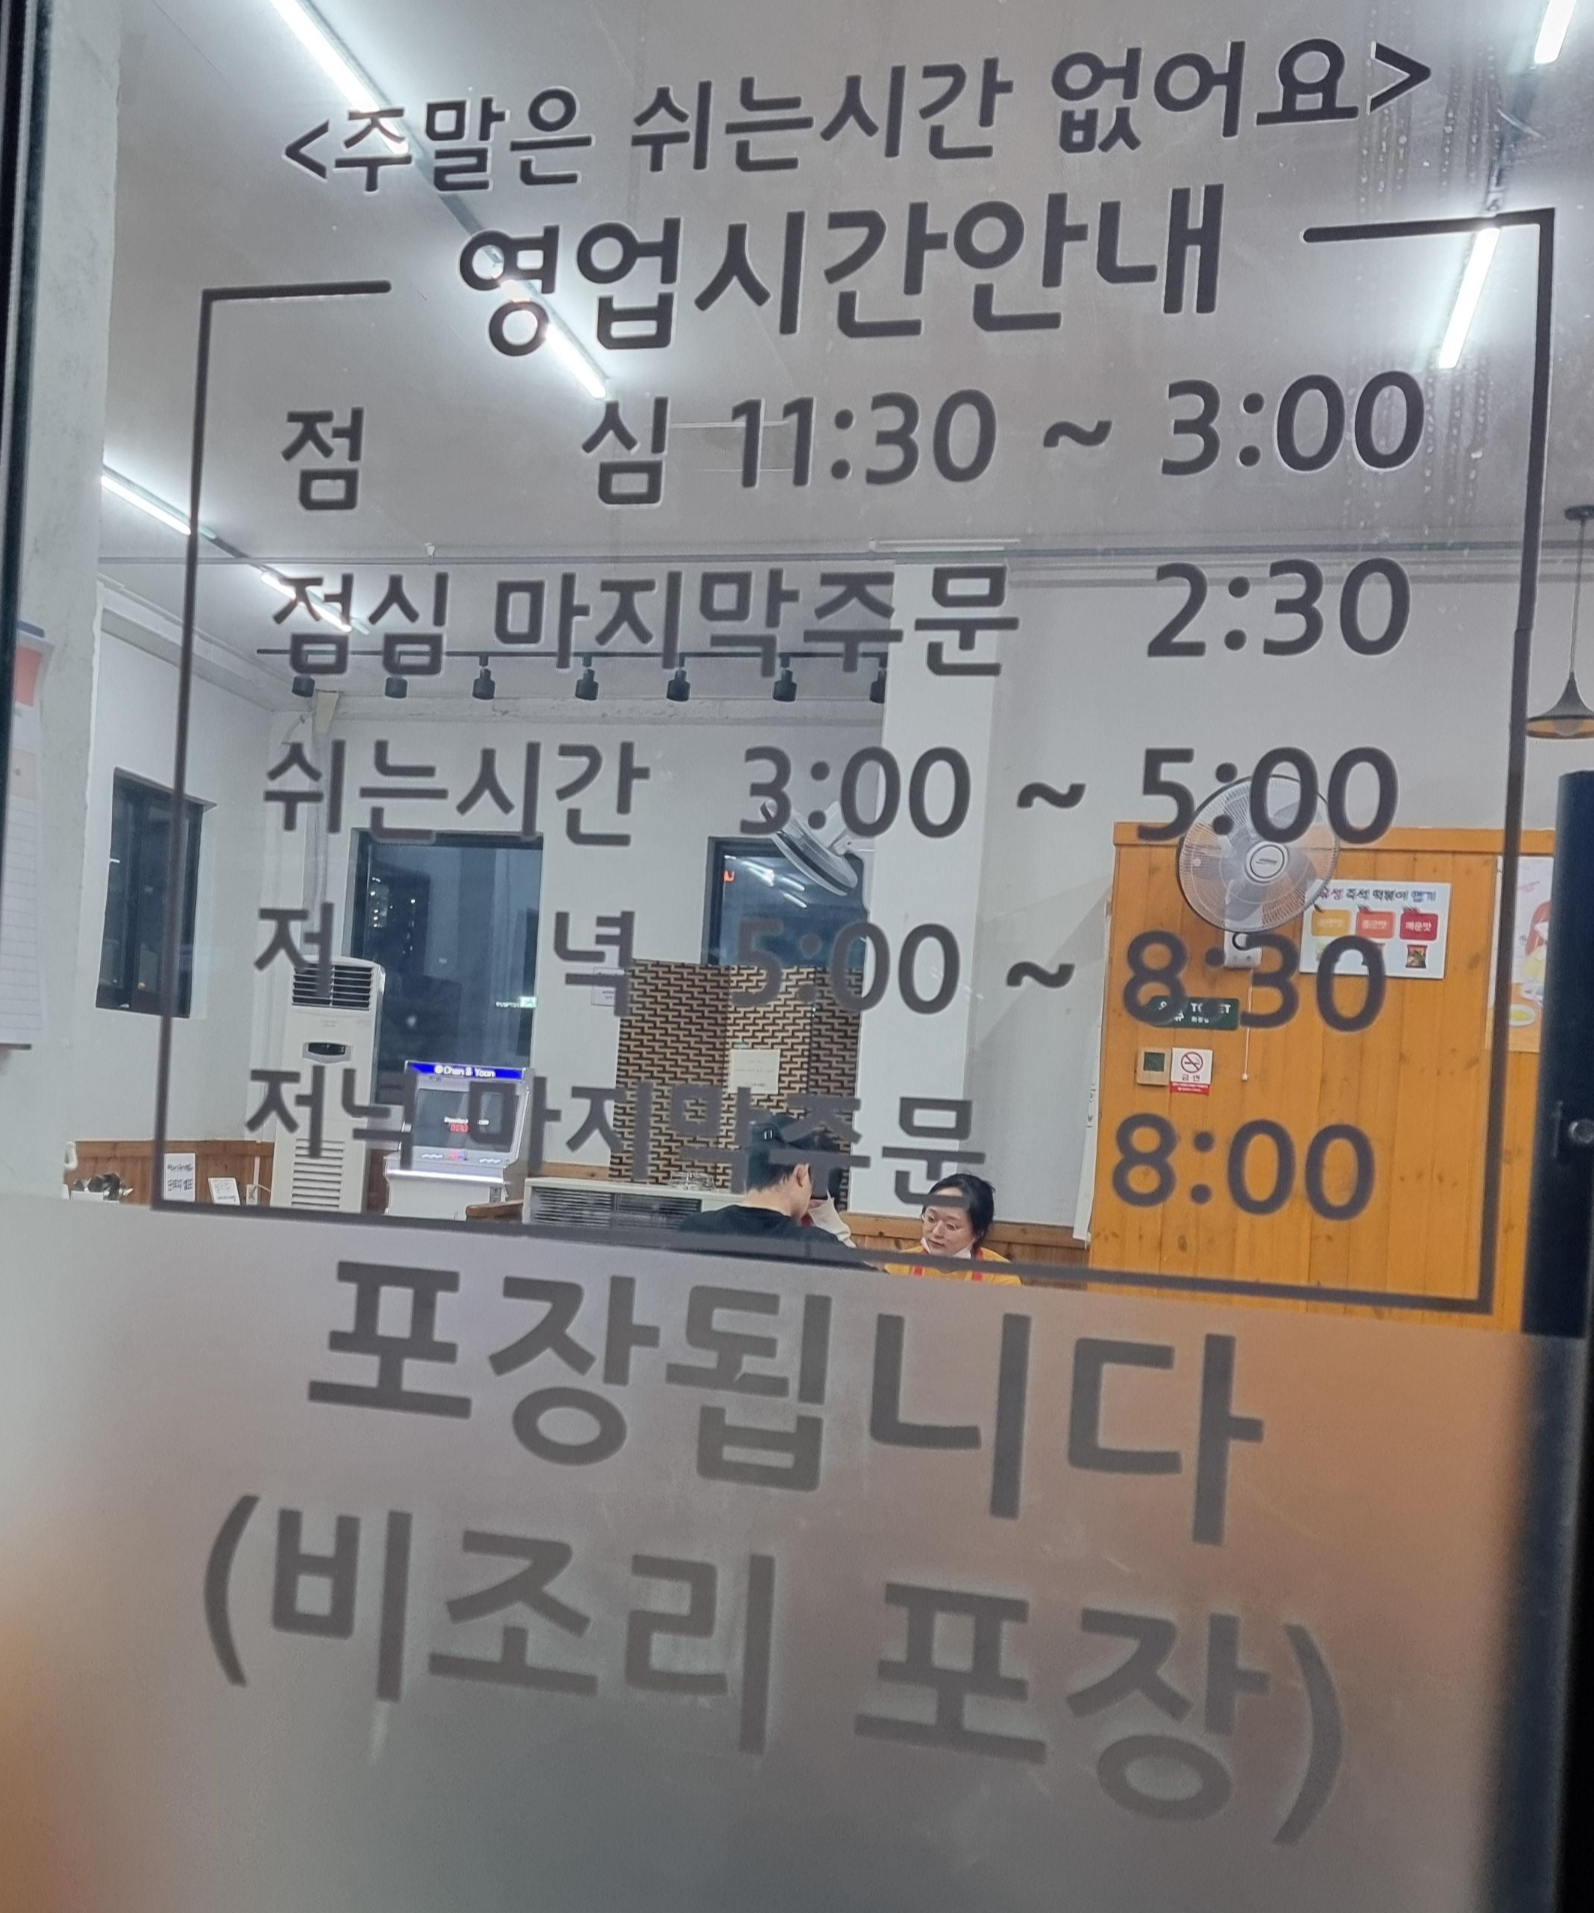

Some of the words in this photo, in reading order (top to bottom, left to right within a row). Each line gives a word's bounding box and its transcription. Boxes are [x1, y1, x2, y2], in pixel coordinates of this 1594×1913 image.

[284, 87, 594, 193] <주말은
[631, 57, 1014, 172] 쉬는시간
[1051, 38, 1432, 153] 없어요>
[459, 184, 1224, 357] 영업시간안내
[731, 389, 997, 488] 11:30
[1043, 419, 1112, 448] ~
[1161, 370, 1426, 476] 3:00
[272, 572, 449, 676] 점심
[495, 566, 1019, 677] 마지막주문
[1147, 558, 1411, 658] 2:30
[263, 740, 650, 847] 쉬는시간
[739, 747, 971, 838] 3:00
[1017, 781, 1086, 809] ~
[1137, 746, 1400, 844] 5:00
[731, 919, 960, 1014] 5:00
[1006, 961, 1075, 988] ~
[1122, 930, 1387, 1032] 8:30
[245, 1065, 418, 1170] 저녁
[467, 1076, 986, 1208] 마지막주문
[1112, 1112, 1376, 1221] 8:00
[308, 1259, 1264, 1546] 포장됩니다
[203, 1494, 775, 1756] (비조리
[855, 1582, 1344, 1846] 포장)
